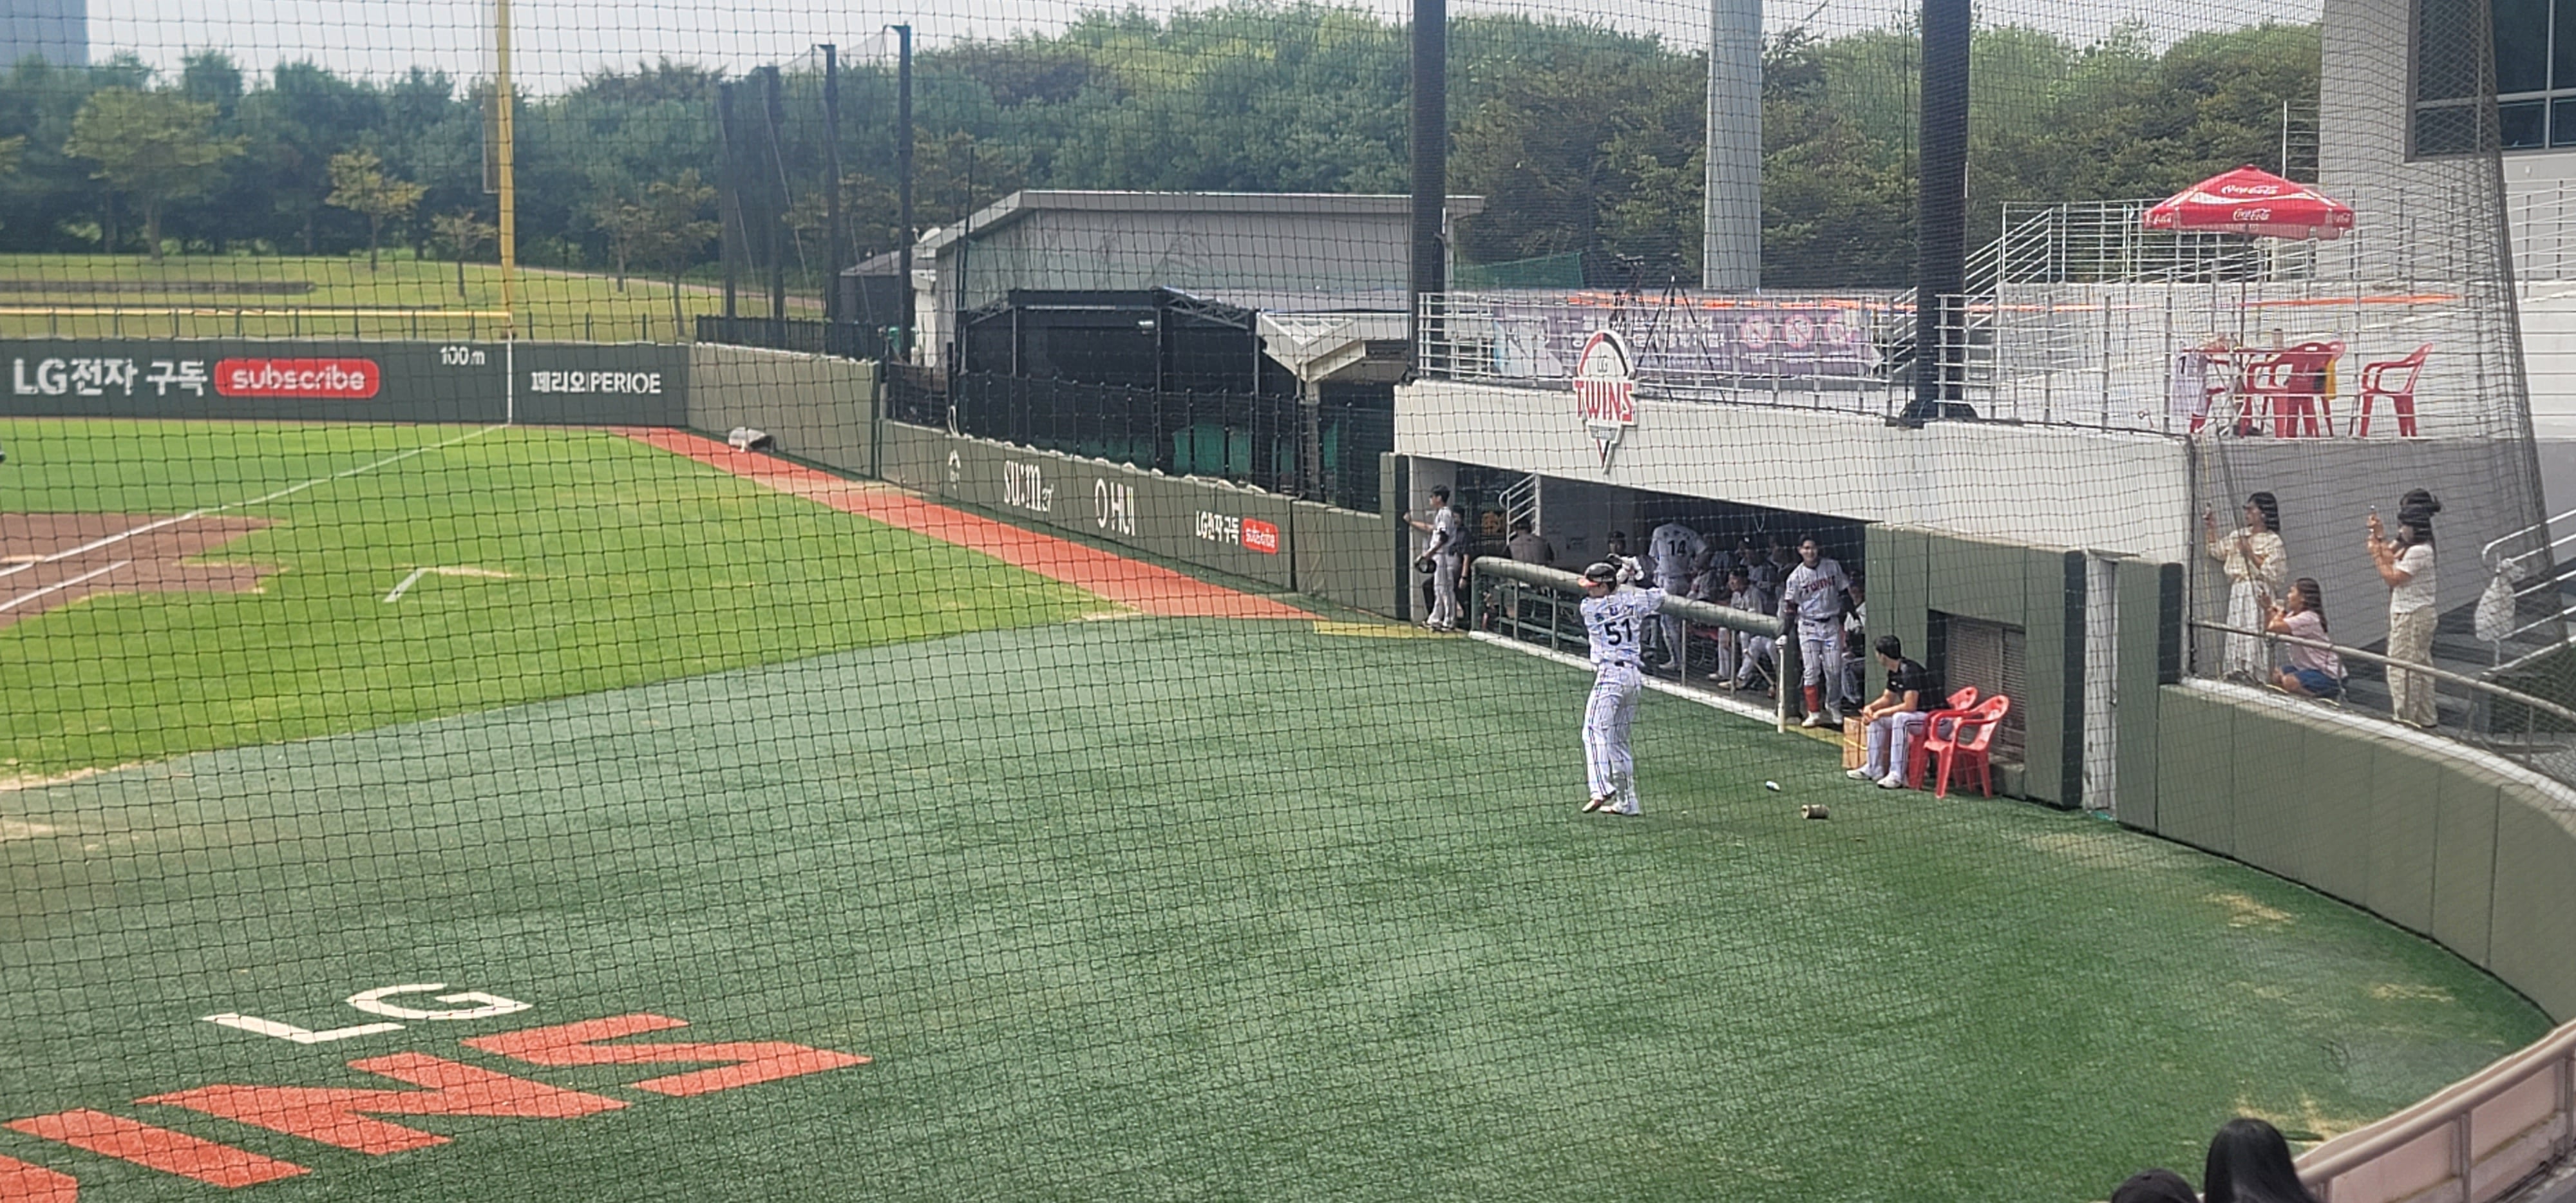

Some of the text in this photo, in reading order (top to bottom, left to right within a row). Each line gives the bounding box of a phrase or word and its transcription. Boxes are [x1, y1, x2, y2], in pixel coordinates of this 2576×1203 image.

[14, 358, 208, 397] LG전자 구독
[231, 363, 365, 390] subscribe
[1573, 379, 1633, 422] TWINS
[1668, 540, 1687, 556] 14
[1604, 618, 1633, 646] 51
[202, 982, 533, 1045] LG
